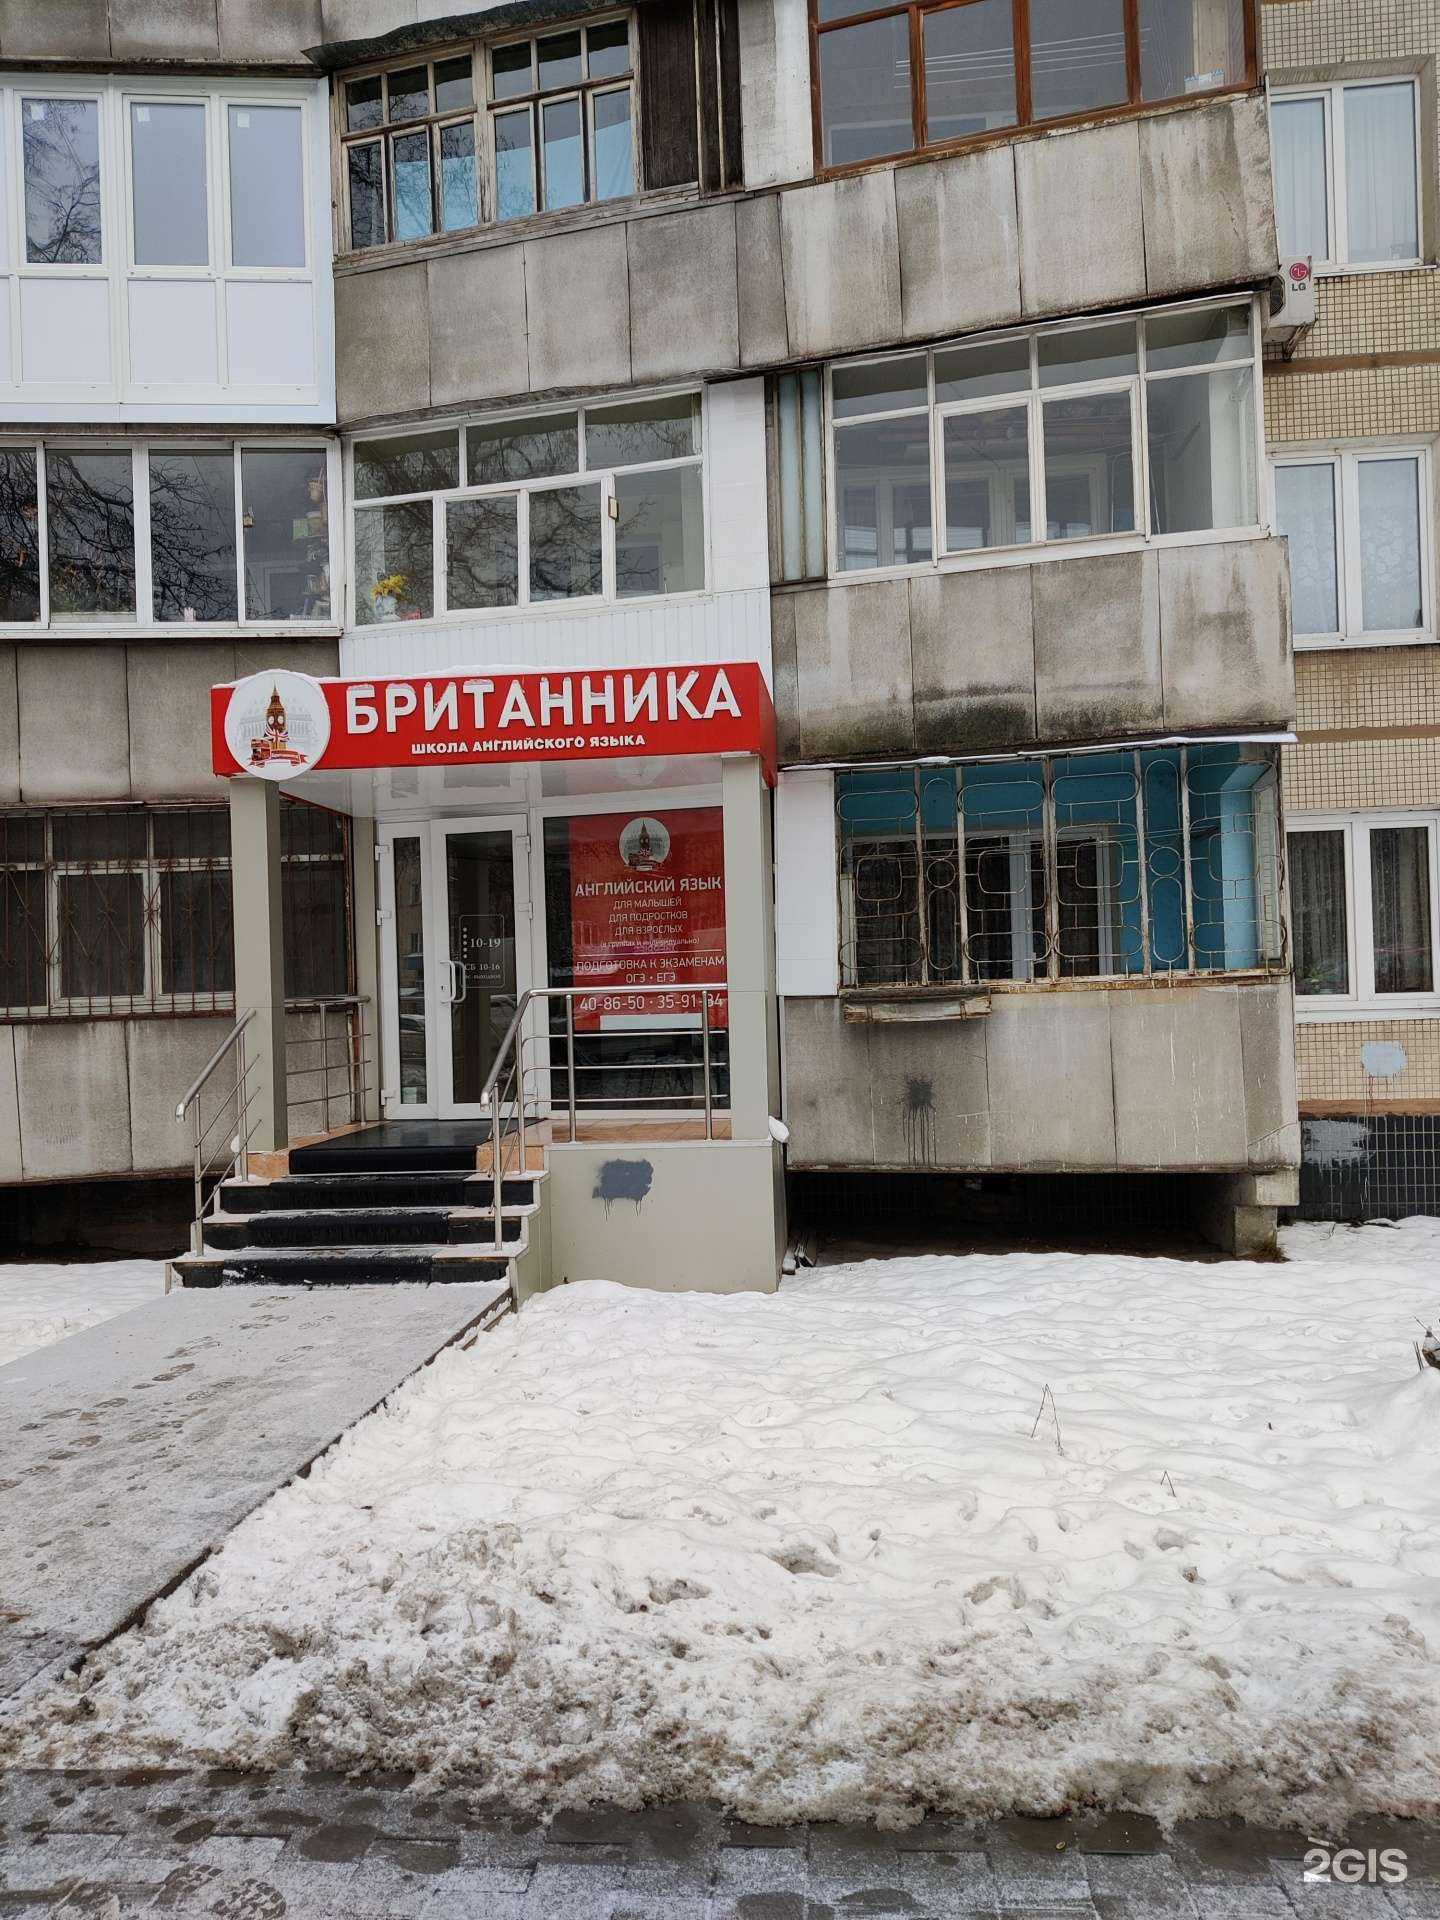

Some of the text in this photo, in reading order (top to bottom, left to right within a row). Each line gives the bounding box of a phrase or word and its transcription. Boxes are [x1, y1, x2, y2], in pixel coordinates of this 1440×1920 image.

[1291, 283, 1307, 292] LG
[346, 667, 742, 735] БРИТАННИКА
[411, 733, 646, 755] ШКОЛА АНГЛИЙСКОГО ЯЗЫКА
[575, 876, 722, 897] АНГЛИЙСКИЙ ЯЗЫК
[613, 897, 682, 910] ДЛЯ МАЛЫШЕЙ
[609, 910, 688, 924] ДЛЯ ПОДРОСТКОВ
[615, 924, 683, 937] ДЛЯ ВЗРОСЛЫХ
[470, 937, 501, 948] 10-19
[480, 963, 500, 971] 10-16
[576, 955, 725, 973] ПОДГОТОВКА К ЭКЗАМЕНАМ
[625, 972, 676, 983] ОГЭ ЕГЭ
[579, 996, 645, 1011] 40-86-50
